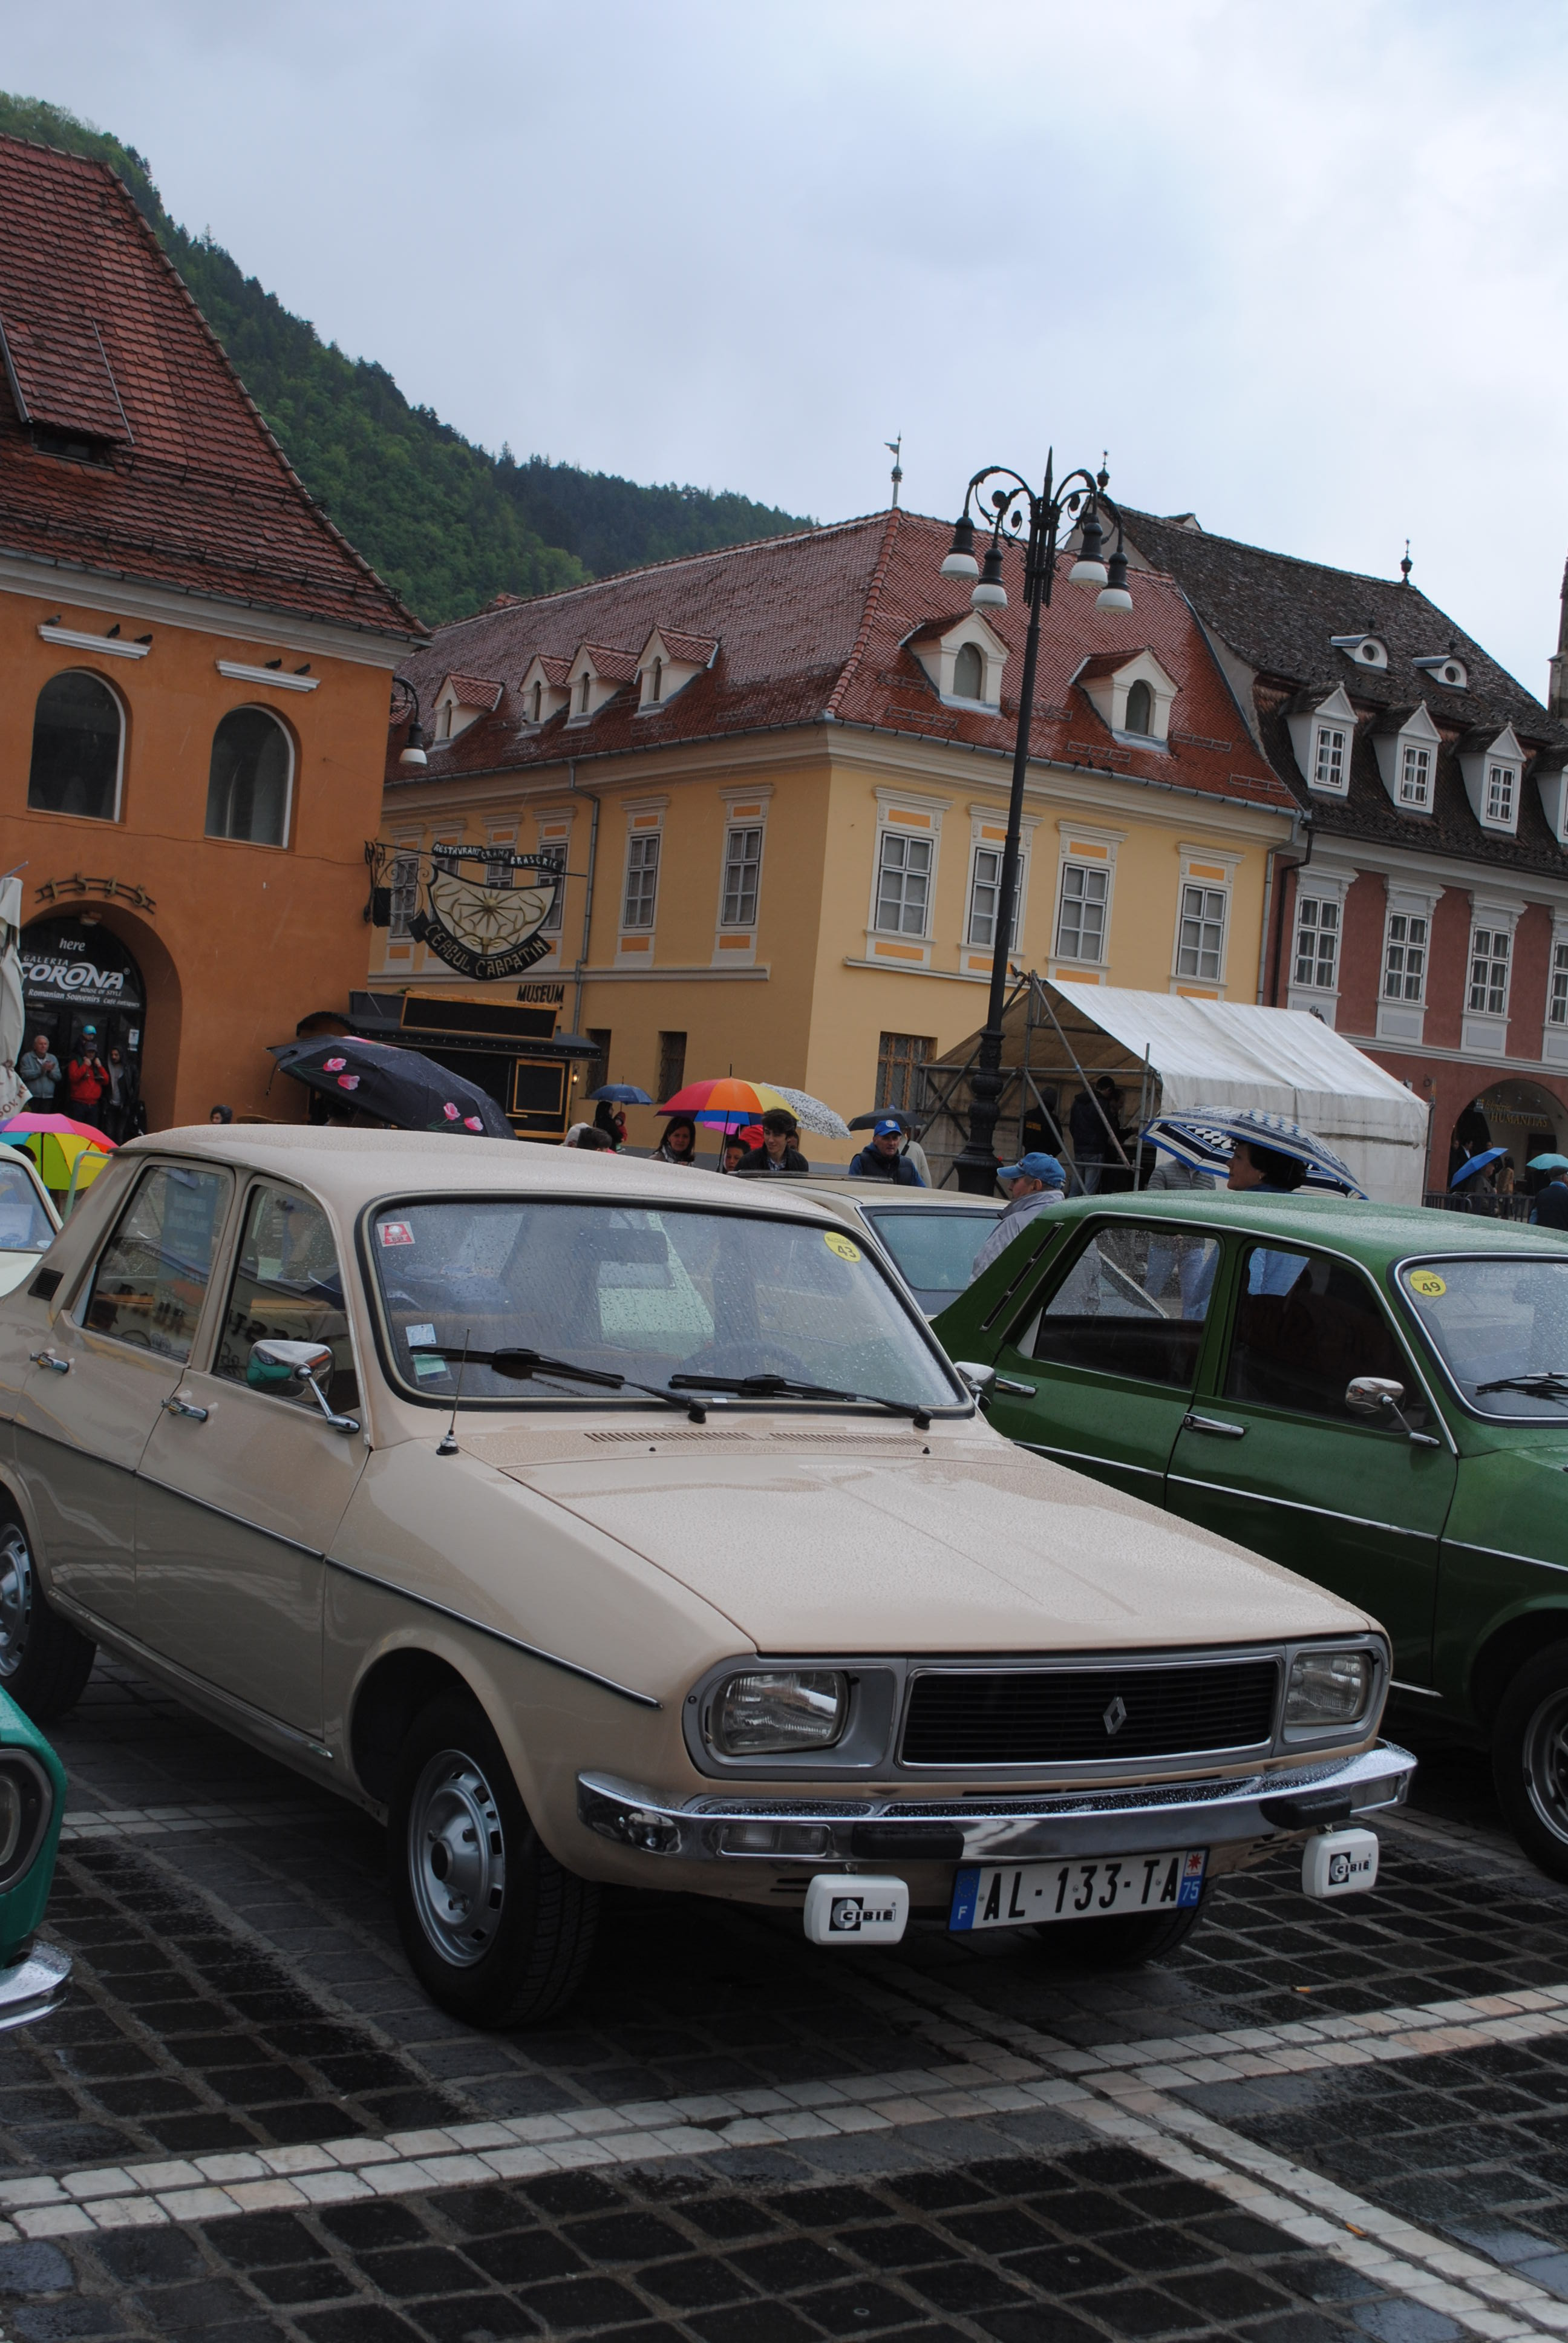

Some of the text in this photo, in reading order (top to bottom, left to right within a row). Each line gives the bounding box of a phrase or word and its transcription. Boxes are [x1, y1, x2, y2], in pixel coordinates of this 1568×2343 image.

[59, 938, 86, 952] here
[22, 955, 69, 966] GALERIA
[21, 962, 124, 991] CORONA
[28, 988, 65, 1000] Romanian
[65, 992, 101, 1003] Souvenirs
[517, 985, 566, 1003] MUSEUM
[1490, 1112, 1547, 1127] HUMANITAS
[837, 1245, 857, 1258] 43
[1422, 1282, 1441, 1293] 49
[1182, 1880, 1200, 1901] 75
[958, 1906, 968, 1920] F
